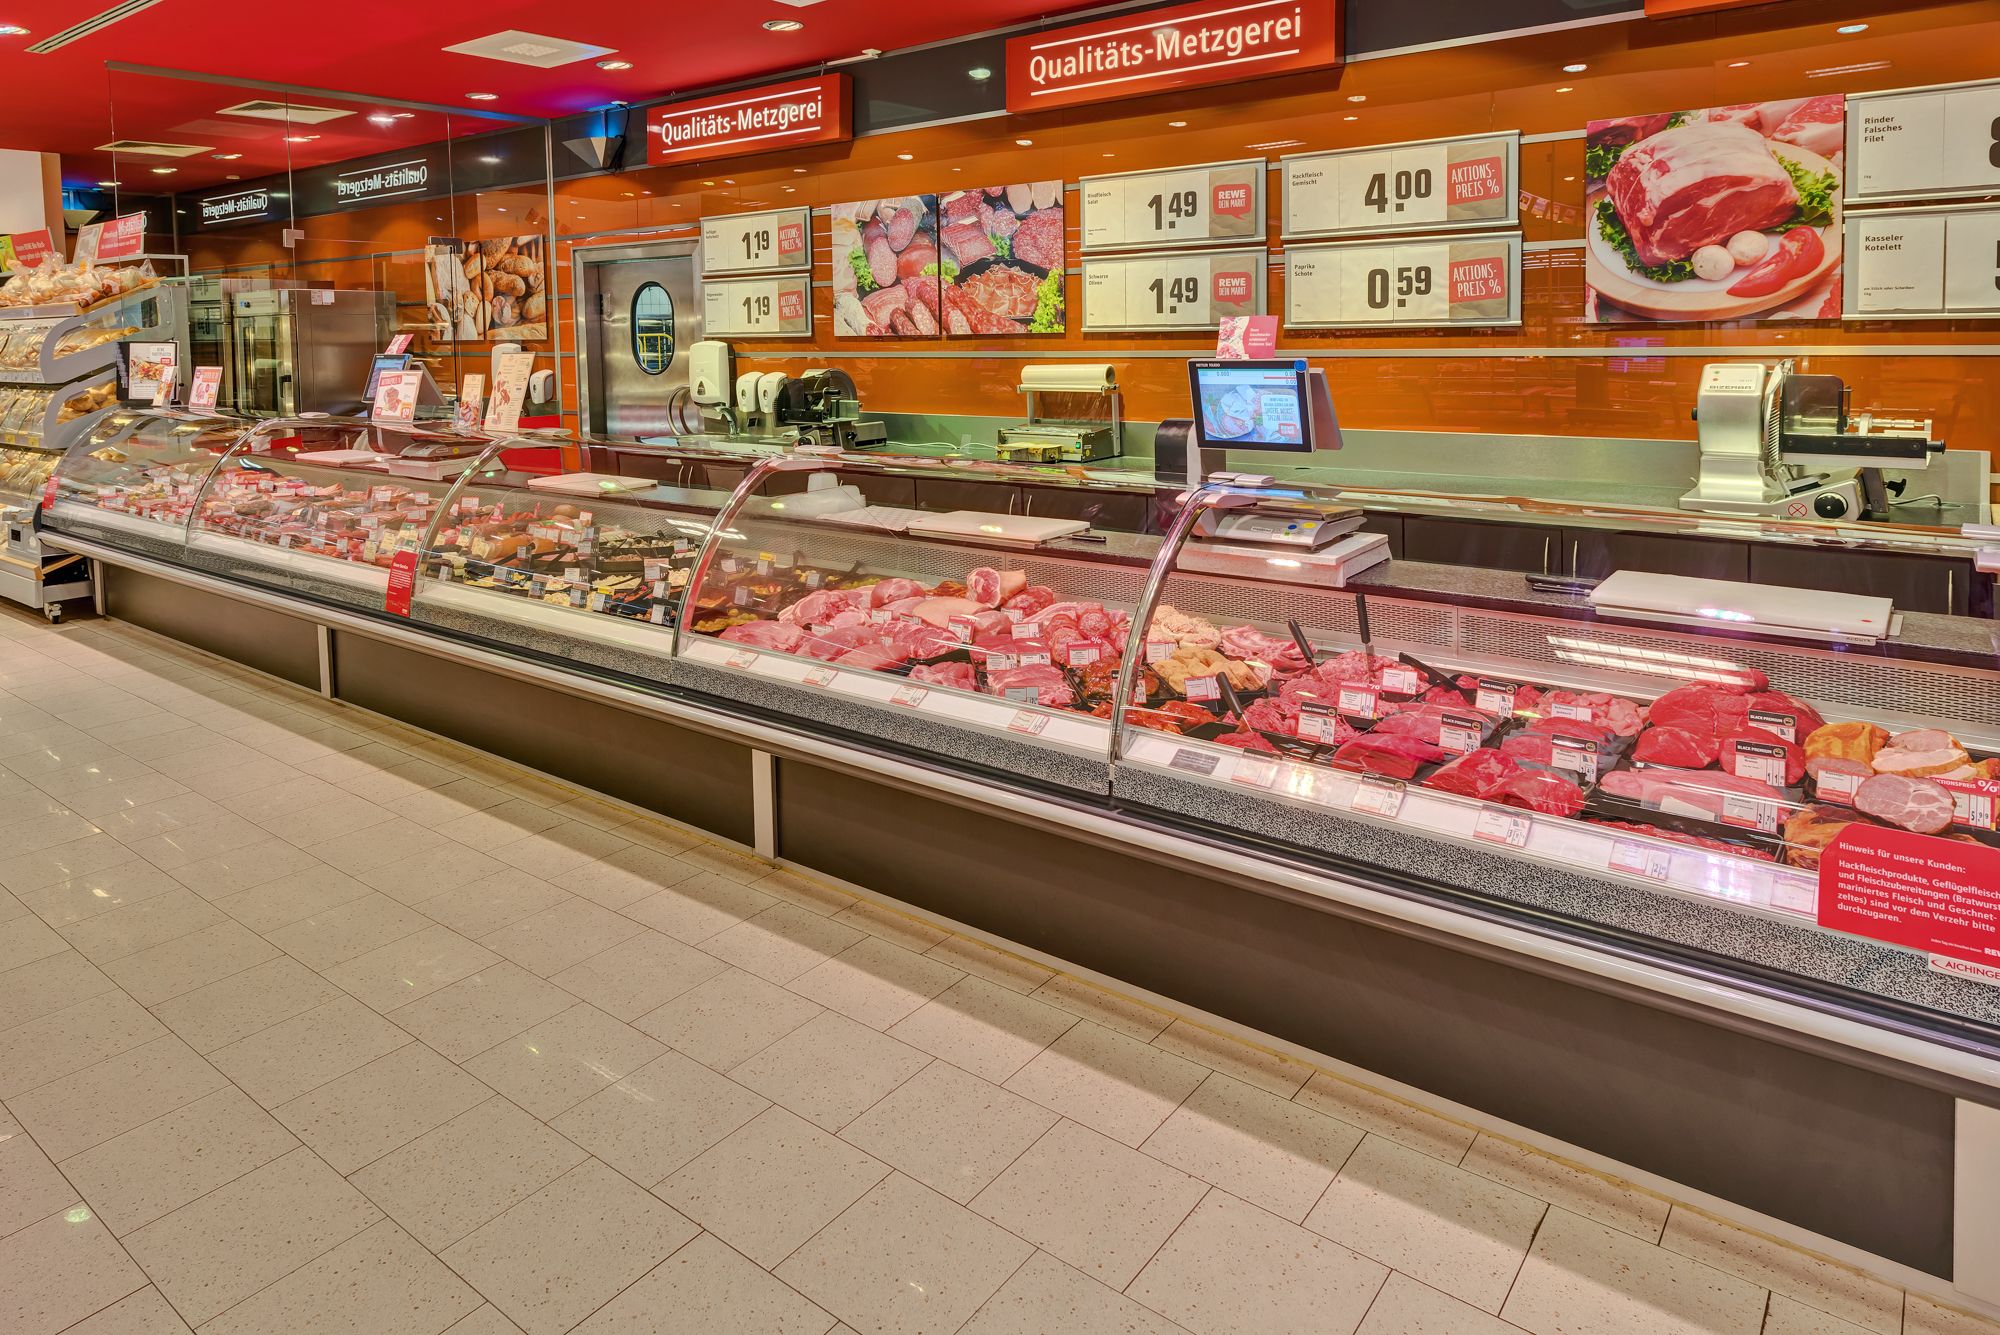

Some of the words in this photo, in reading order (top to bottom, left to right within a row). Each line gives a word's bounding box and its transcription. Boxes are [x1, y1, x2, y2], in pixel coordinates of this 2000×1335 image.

[1029, 7, 1302, 85] Qualitäts-Metzgerei
[661, 95, 823, 146] Qualitäts-Metzgerei
[1864, 115, 1895, 125] Rinder
[1864, 124, 1903, 134] Falsches
[1864, 135, 1885, 143] Filet
[1292, 171, 1324, 179] Hackfleisch
[1451, 162, 1495, 184] AKTIONS-
[1218, 189, 1246, 200] REWE
[1364, 168, 1432, 214] 4.00
[1455, 181, 1484, 200] PREIS
[1486, 178, 1500, 195] %
[1147, 190, 1198, 231] 1.49
[1218, 200, 1230, 208] DEIN
[1230, 198, 1246, 208] MARKT
[779, 227, 800, 241] AKTIONS-
[1865, 234, 1904, 243] Kasseler
[742, 230, 770, 260] 1.19
[782, 239, 795, 251] PREIS
[1865, 243, 1902, 251] Kotelett
[1294, 263, 1315, 271] Paprika
[1453, 263, 1497, 283] AKTIONS-
[1218, 277, 1246, 287] REWE
[1218, 288, 1230, 296] DEIN
[1230, 286, 1246, 295] MARKT
[1367, 265, 1432, 310] 0.59
[1457, 281, 1486, 298] PREIS
[1488, 278, 1501, 294] %
[780, 293, 801, 307] AKTIONS-
[1148, 277, 1199, 314] 1.49
[742, 295, 770, 324] 1.19
[782, 305, 796, 317] PREIS
[1977, 780, 1998, 793] %
[1839, 841, 1875, 857] Hinweis
[1877, 849, 1891, 859] für
[1893, 854, 1925, 866] unsere
[1927, 858, 1967, 874] Kunden:
[1838, 871, 1855, 881] und
[1857, 874, 1950, 901] Fleischzubereitungen
[1839, 860, 1930, 886] Hackfleischprodukte,
[1932, 879, 2000, 901] Geflügelfleisch
[1838, 882, 1889, 899] mariniertes
[1892, 892, 1925, 907] Fleisch
[1927, 900, 1946, 911] und
[1948, 904, 1998, 922] Geschnet-
[1837, 892, 1868, 906] zeltes)
[1870, 899, 1890, 910] sind
[1892, 905, 1908, 914] vor
[1910, 907, 1931, 919] dem
[1932, 912, 1974, 927] Verzehr
[1972, 919, 1997, 933] bitte
[1837, 902, 1903, 924] durchzugaren.
